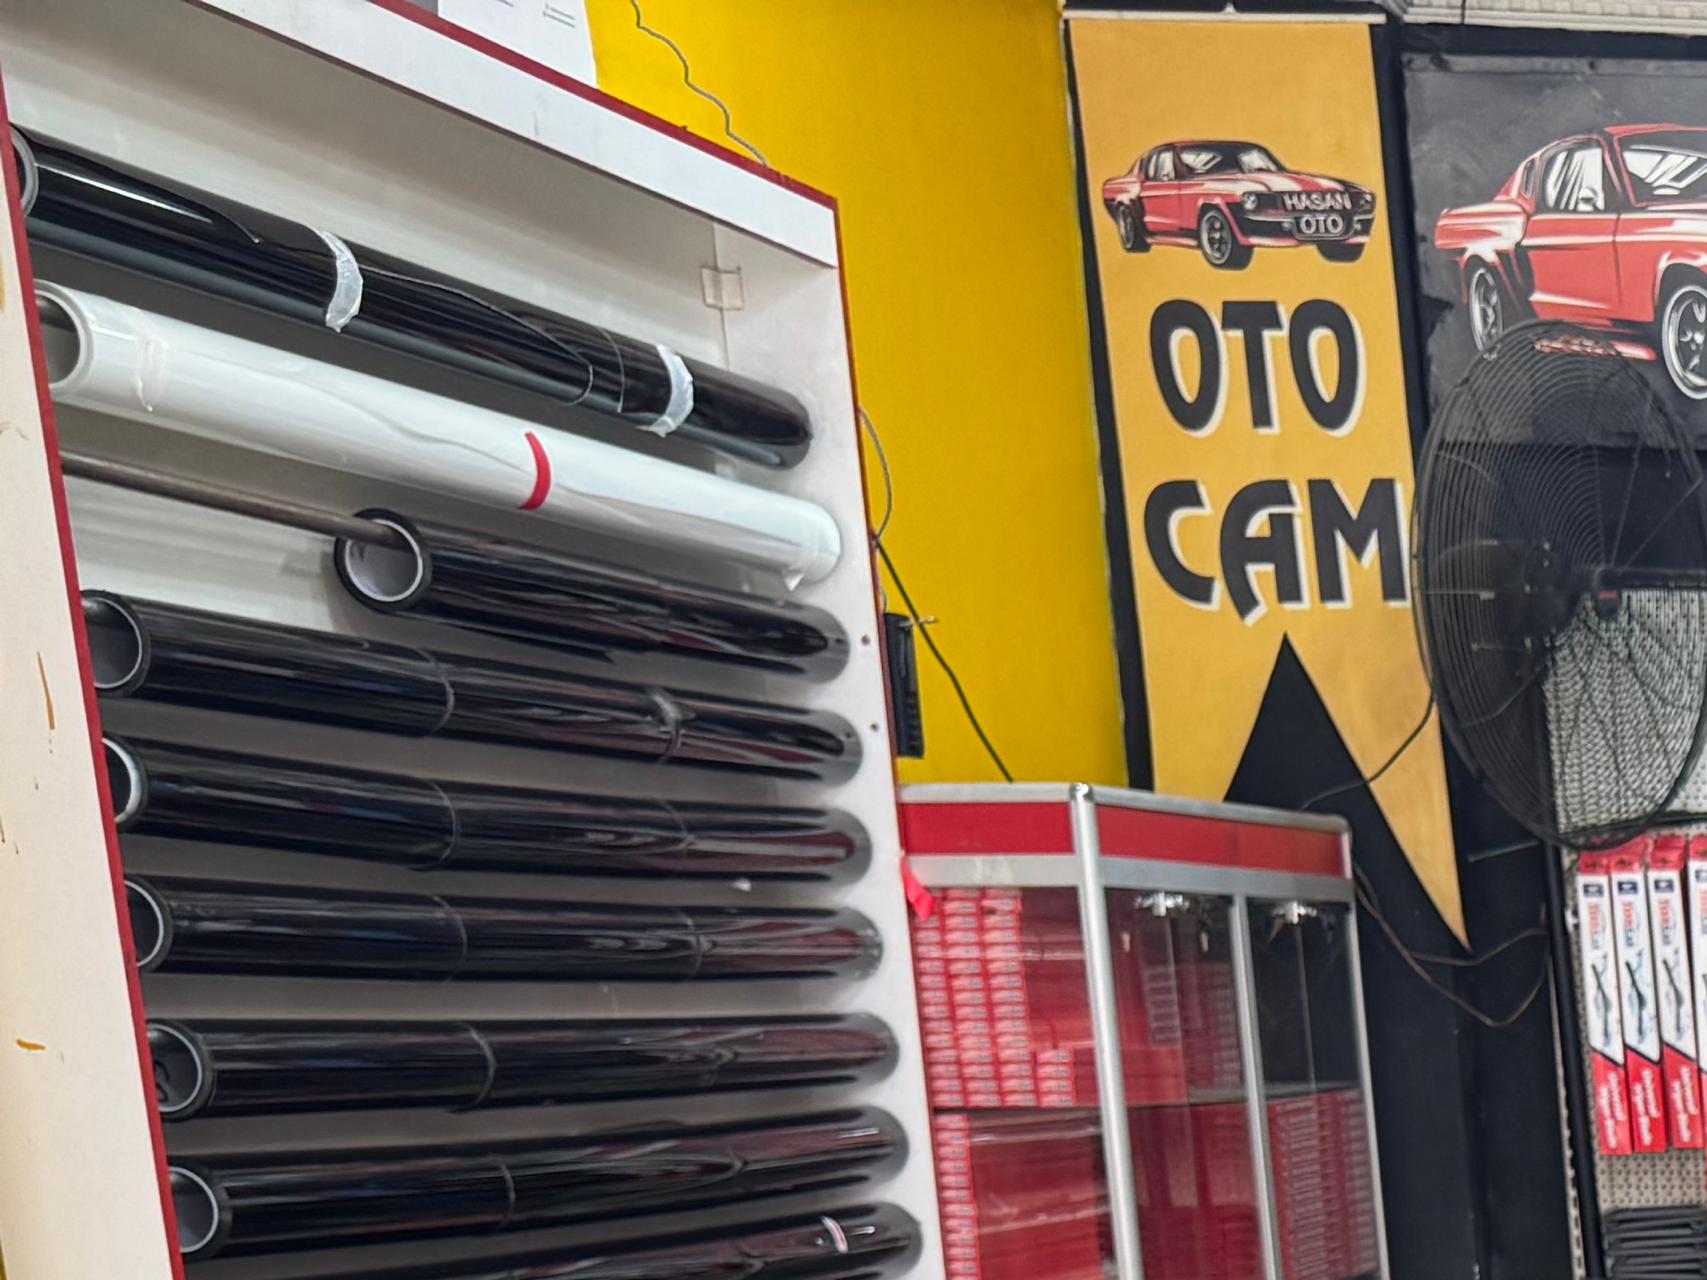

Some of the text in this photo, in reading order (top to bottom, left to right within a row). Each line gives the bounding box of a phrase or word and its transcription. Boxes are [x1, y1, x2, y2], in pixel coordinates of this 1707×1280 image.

[1285, 191, 1352, 211] HASAN
[1300, 214, 1343, 234] OTO
[1149, 300, 1364, 434] OTO
[1144, 479, 1409, 624] CAM
